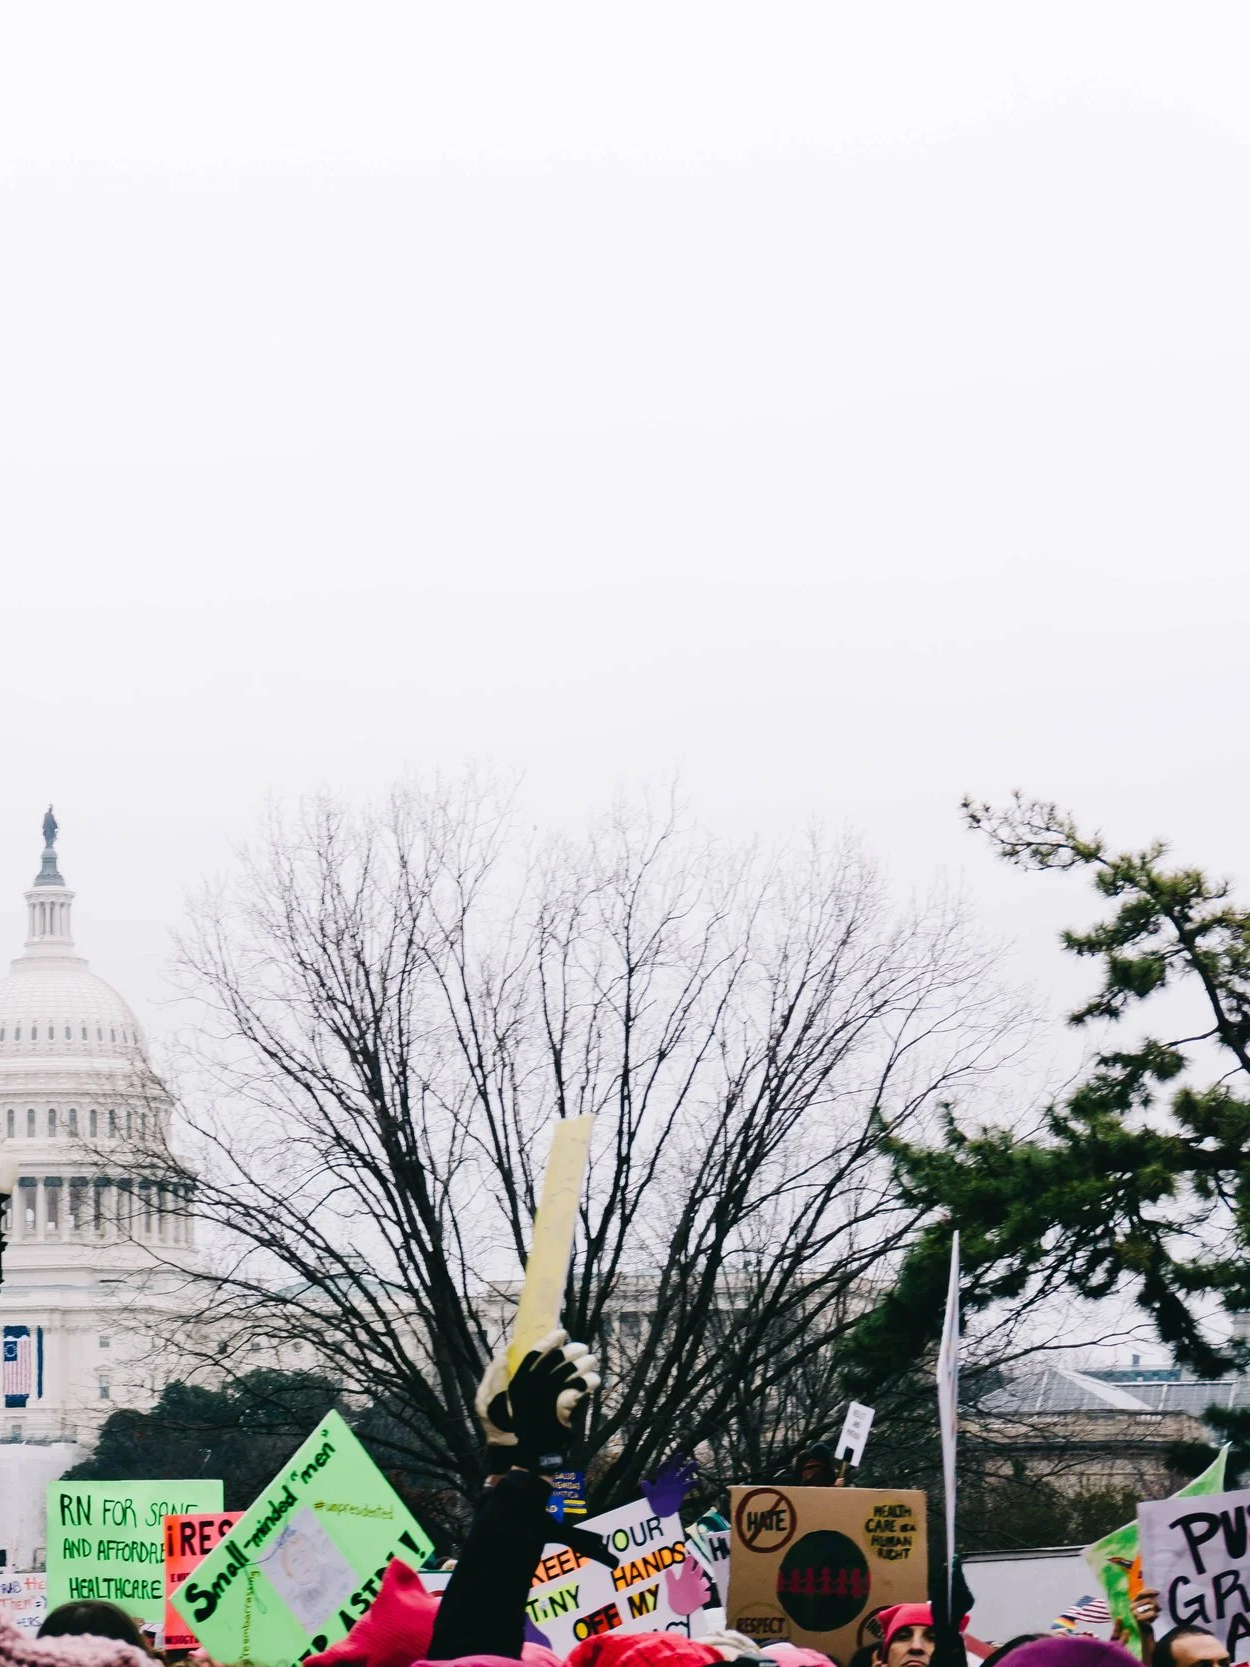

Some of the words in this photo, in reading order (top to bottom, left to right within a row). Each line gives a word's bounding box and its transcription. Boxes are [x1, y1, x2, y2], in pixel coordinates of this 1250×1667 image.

[60, 1493, 93, 1527] RN
[103, 1498, 138, 1529] FOR
[746, 1508, 788, 1532] HATE
[865, 1518, 897, 1533] CARE
[63, 1537, 92, 1560] AND
[1168, 1505, 1250, 1575] PU
[610, 1540, 686, 1592] HANDS
[69, 1576, 164, 1600] HEALTHCARE
[573, 1602, 621, 1642] OFF
[626, 1583, 660, 1619] MY
[736, 1617, 787, 1635] RESPECT
